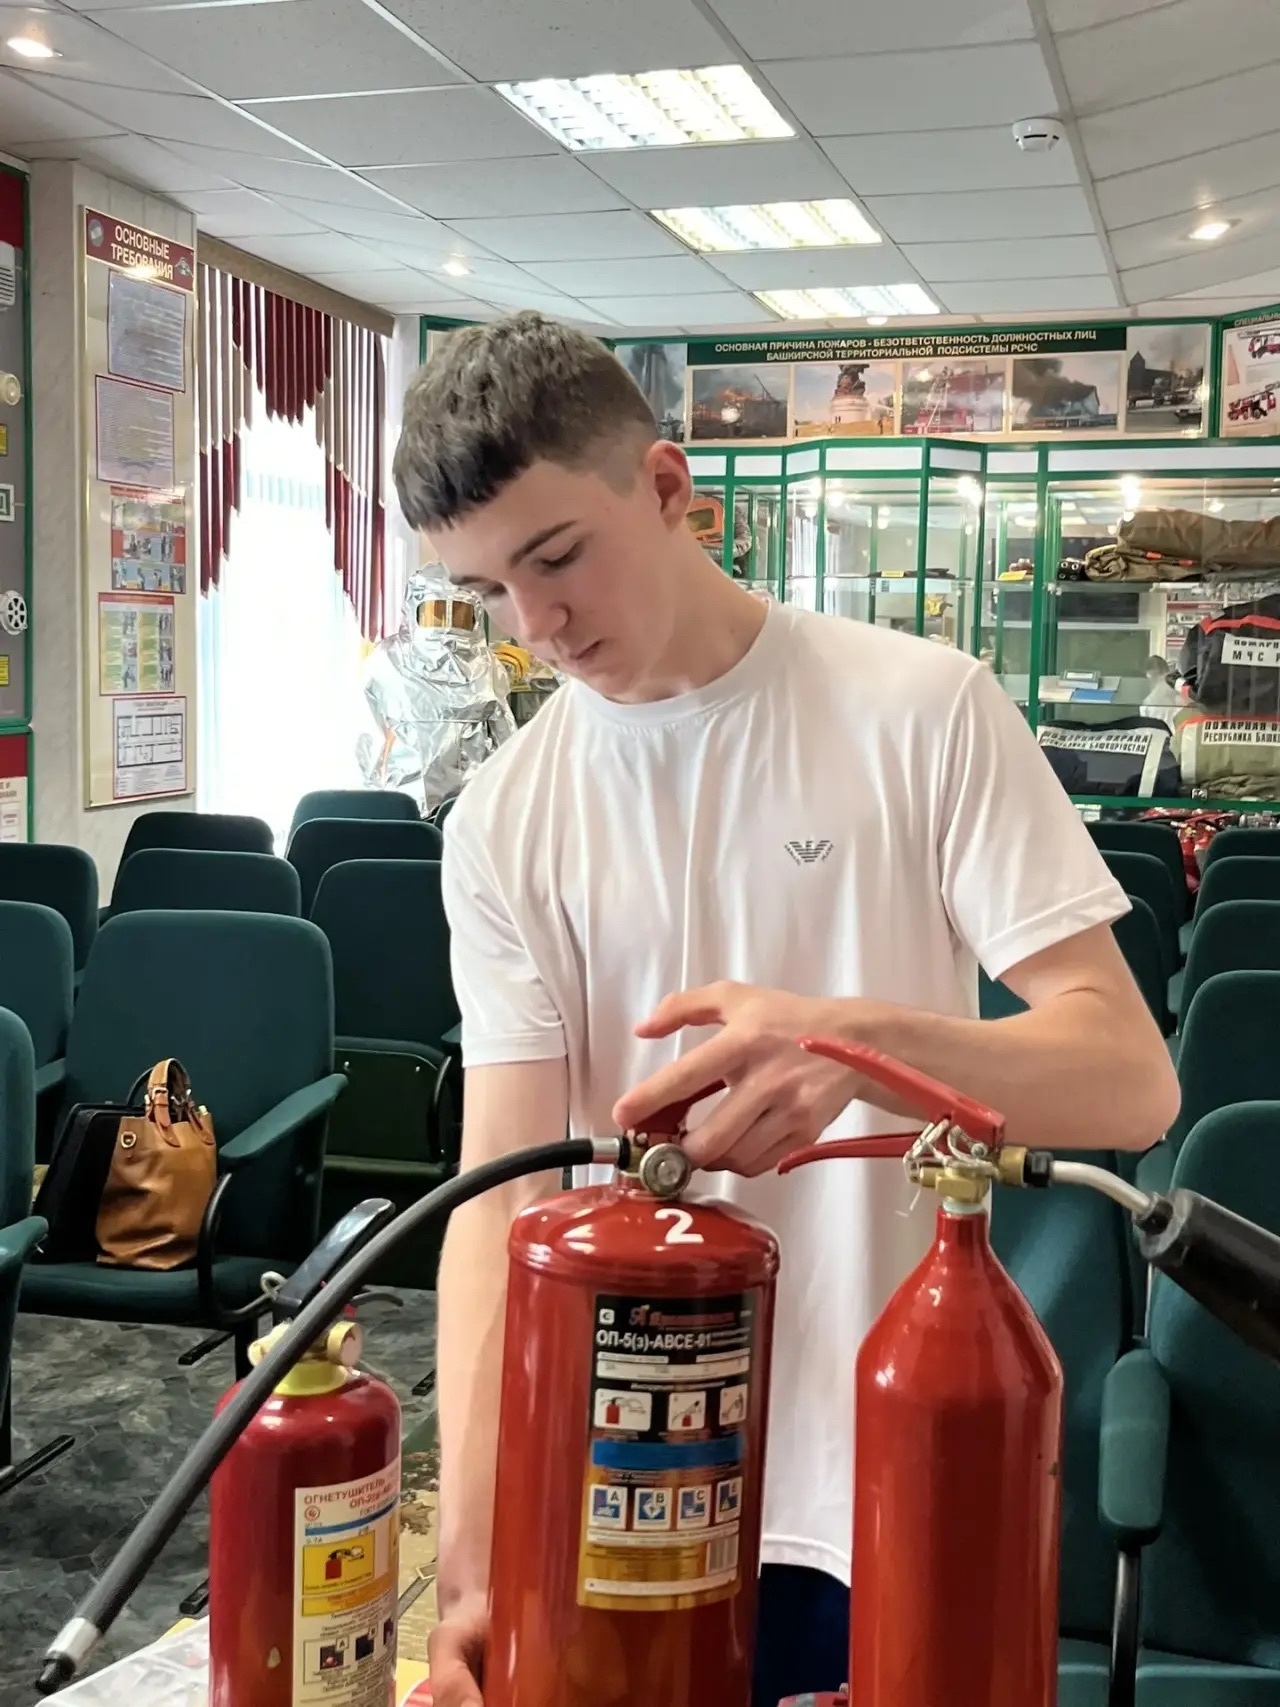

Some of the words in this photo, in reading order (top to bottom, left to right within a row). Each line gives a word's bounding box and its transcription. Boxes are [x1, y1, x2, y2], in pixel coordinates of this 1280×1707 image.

[115, 225, 170, 260] ОСНОВНЫЕ
[715, 342, 767, 353] ОСНОВНАЯ
[769, 340, 815, 351] ПРИЧИНА
[817, 338, 866, 349] ПОЖАРОВ
[873, 335, 990, 347] БЕЗОТВЕТСТВЕННОСТЬ
[991, 332, 1072, 344] ДОЛЖНОСТНЫХ
[1074, 330, 1097, 341] ЛИЦ
[766, 350, 833, 361] БАШКИРСКОЙ
[836, 345, 933, 358] ТЕРРИТОРИАЛЬНОЙ
[937, 343, 1009, 355] ПОДСИСТЕМЫ
[1011, 342, 1038, 353] РСЧС
[1204, 732, 1252, 742] РЕСПУБЛИКА
[1205, 720, 1266, 731] ПОЖАРНАЯ
[655, 1208, 704, 1244] 2
[304, 1478, 386, 1504] ОГНЕТУШИТЕЛЬ
